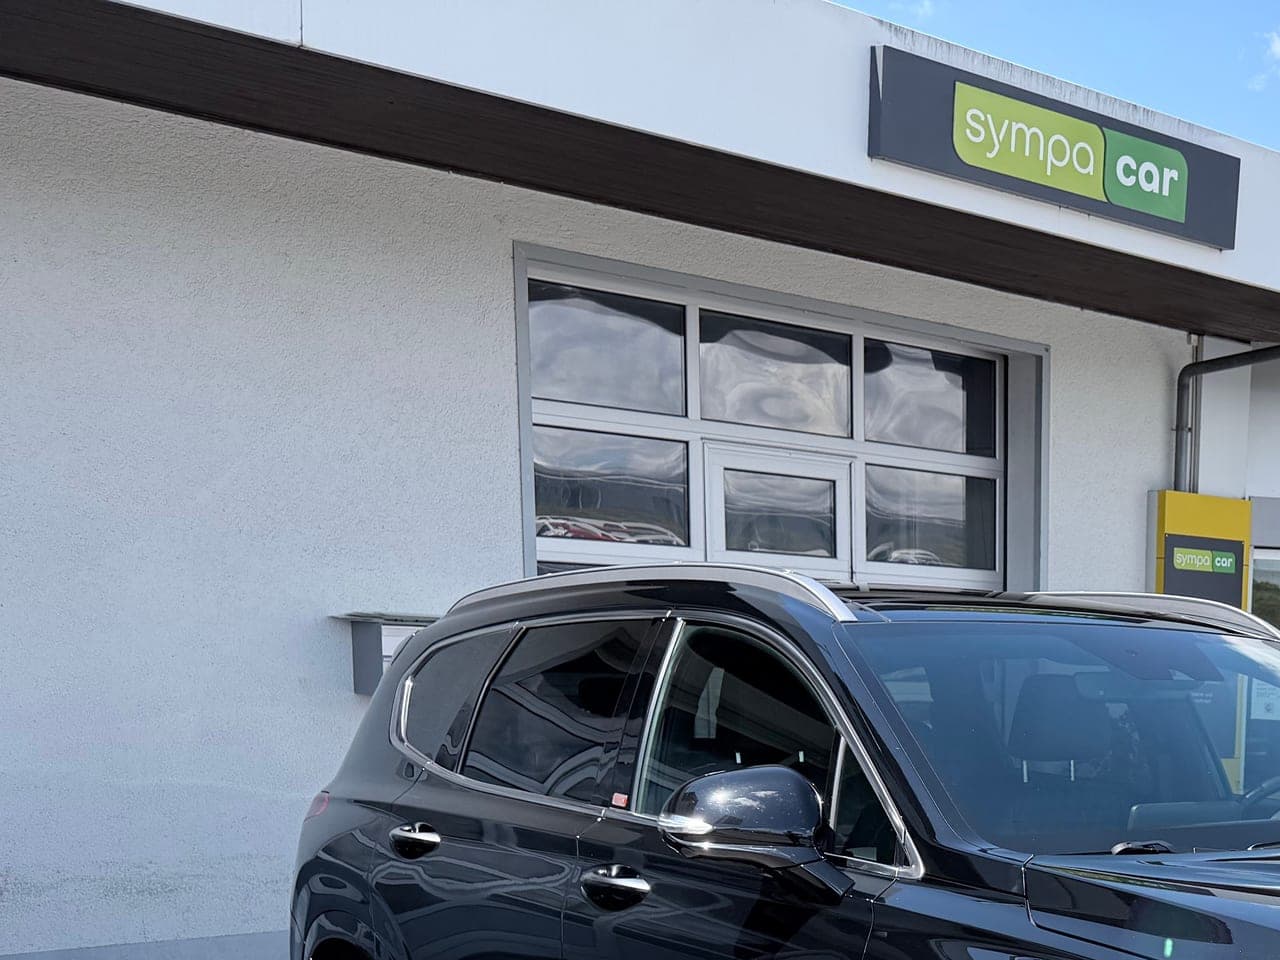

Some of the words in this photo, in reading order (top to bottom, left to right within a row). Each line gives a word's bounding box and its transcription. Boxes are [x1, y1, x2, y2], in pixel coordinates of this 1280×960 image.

[965, 108, 1095, 176] sympa
[1115, 154, 1180, 197] car
[1176, 553, 1210, 568] sympa
[1215, 556, 1233, 568] car
